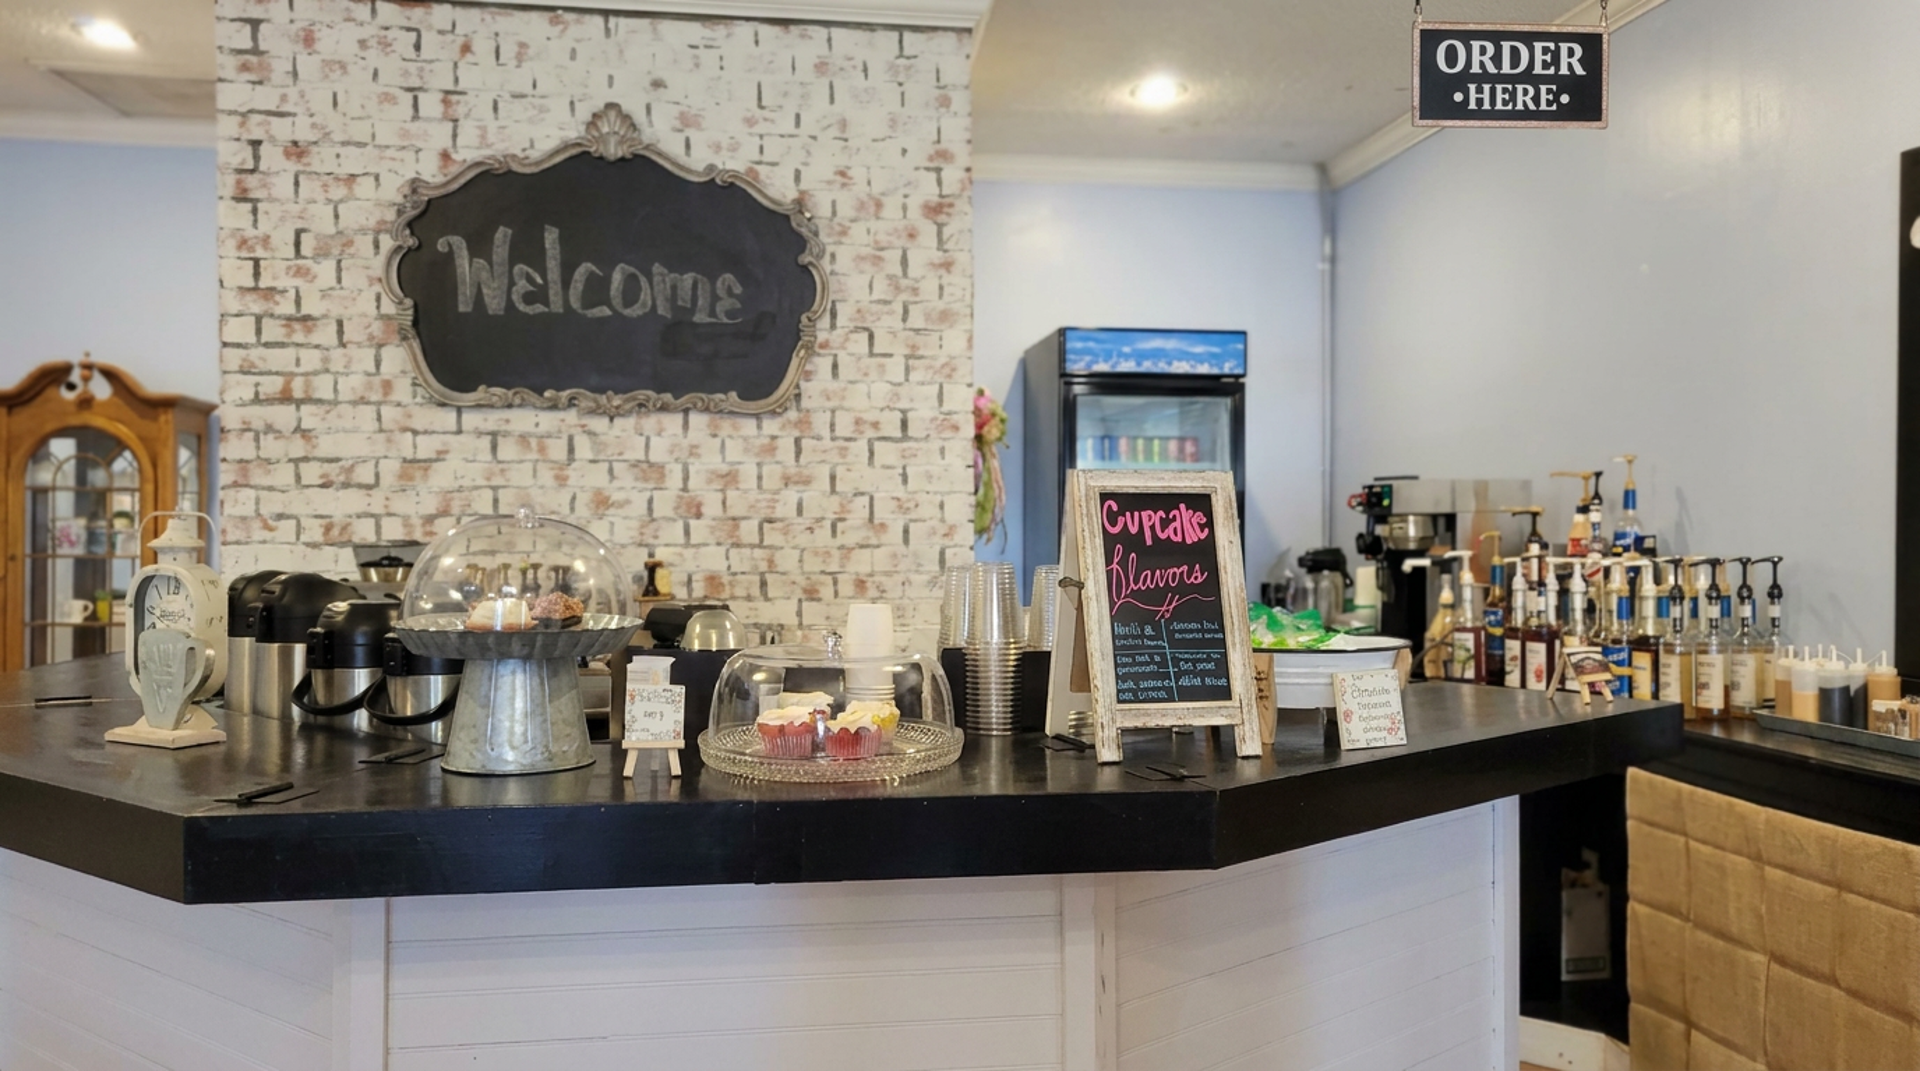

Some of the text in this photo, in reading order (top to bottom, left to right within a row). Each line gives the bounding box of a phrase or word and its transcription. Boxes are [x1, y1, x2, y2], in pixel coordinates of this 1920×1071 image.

[1436, 39, 1586, 75] ORDER
[437, 224, 743, 323] Welcome
[1102, 499, 1209, 546] Cupcake
